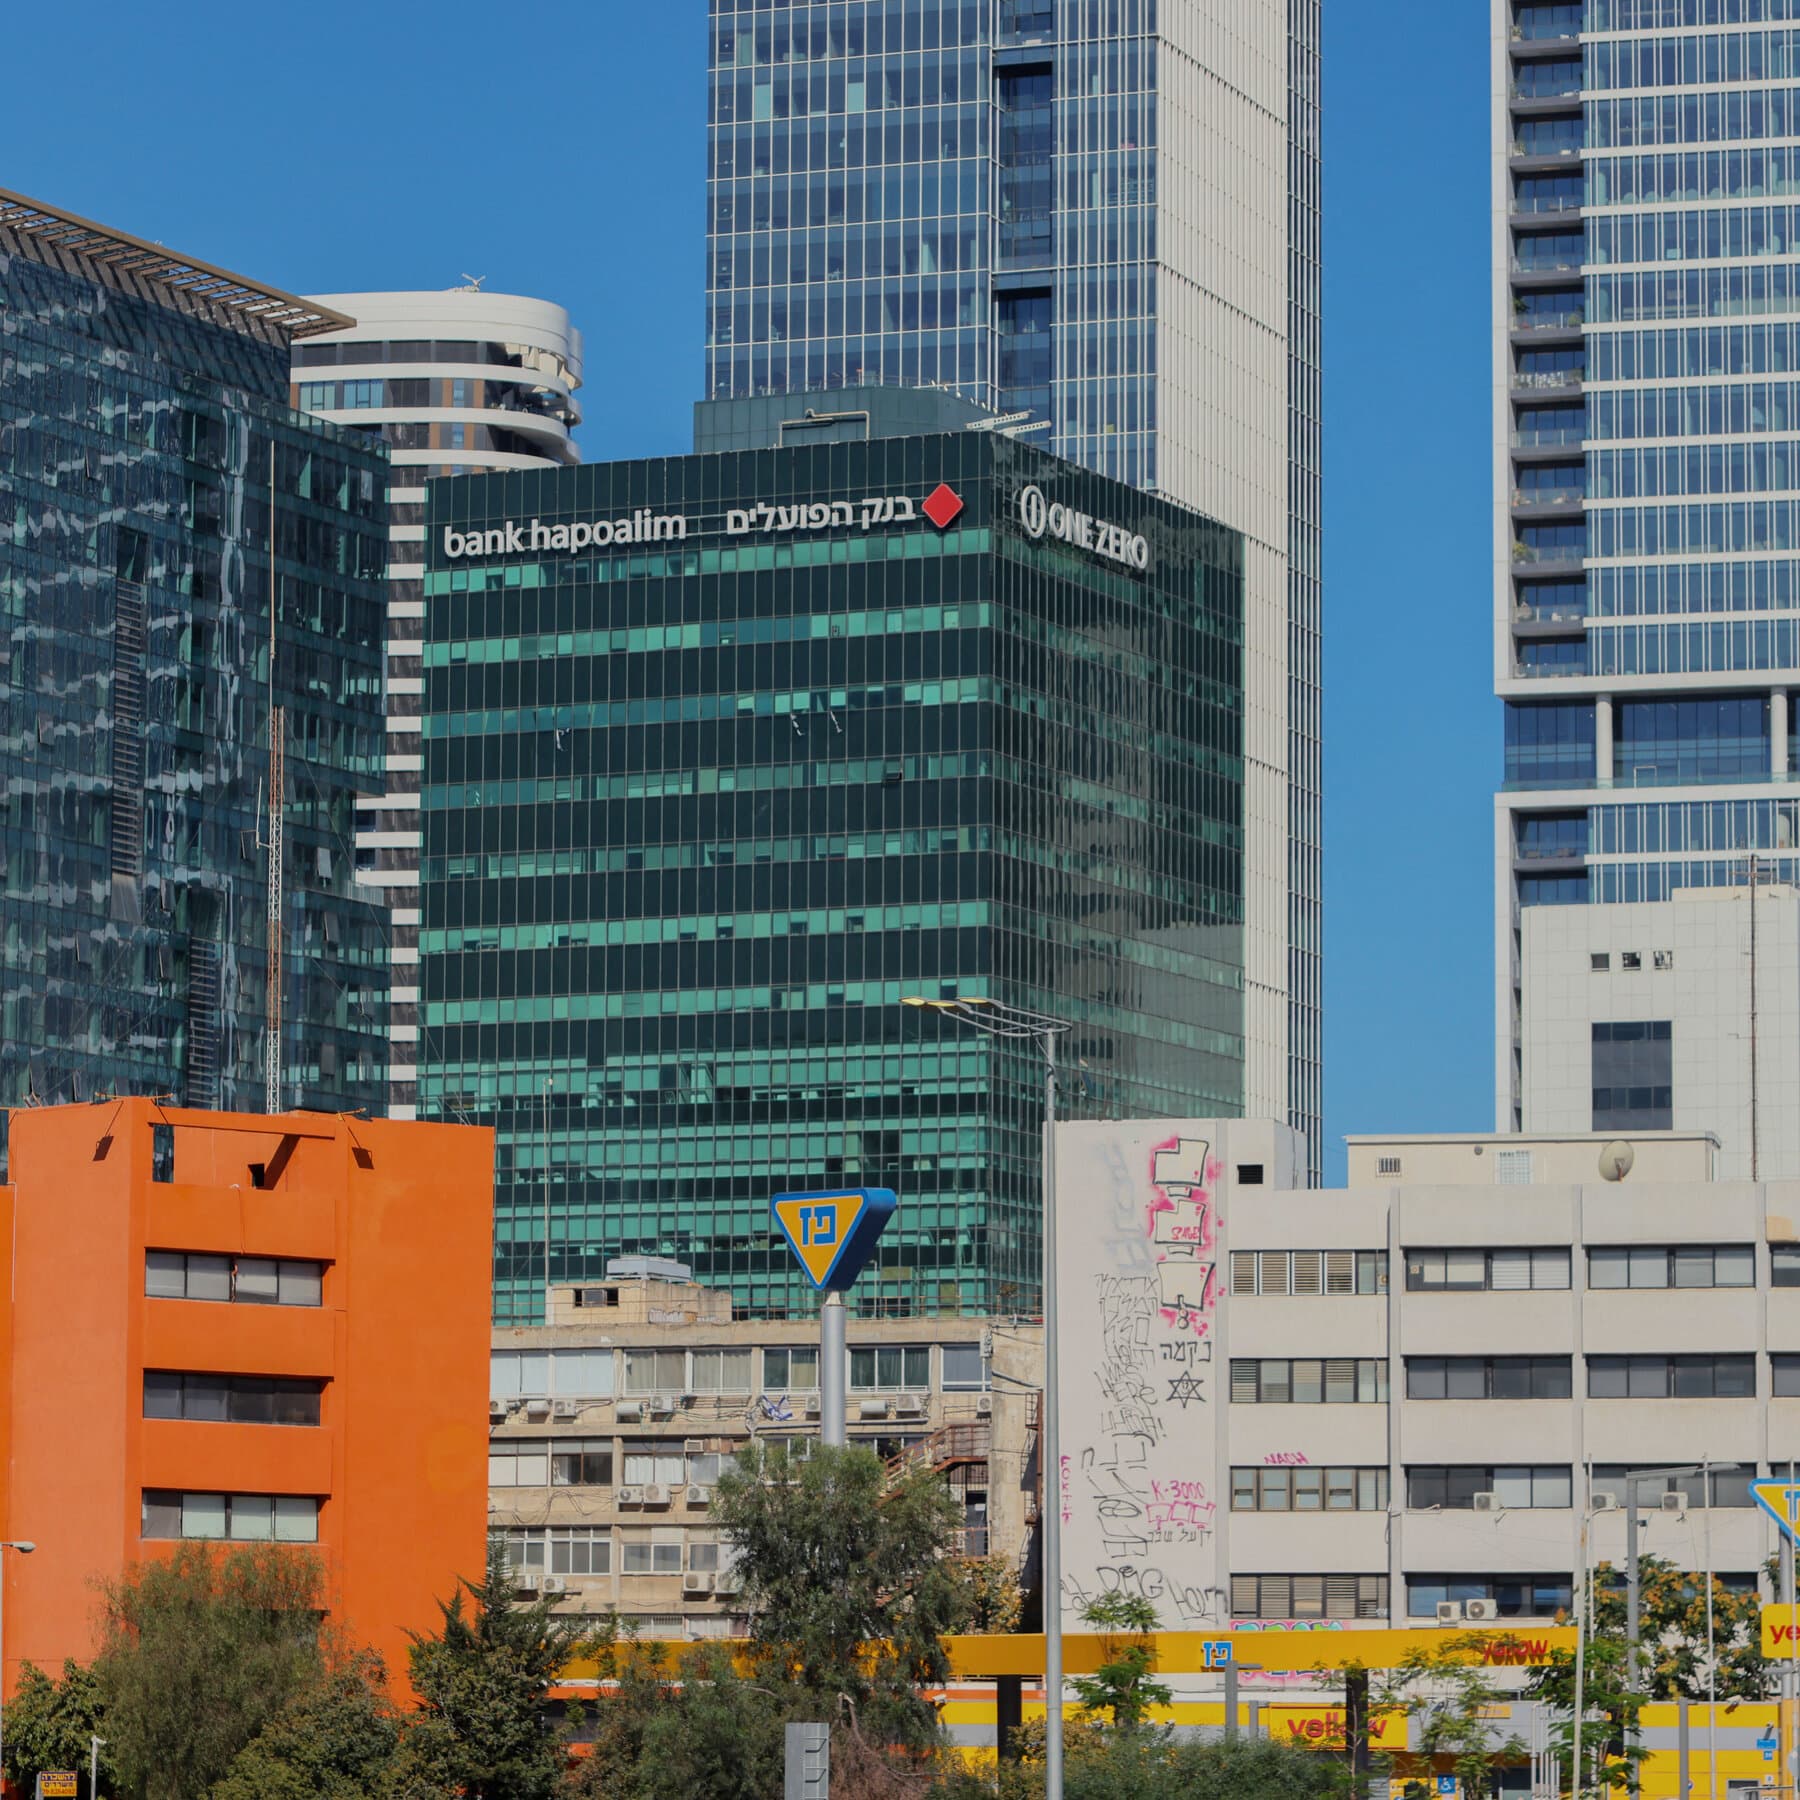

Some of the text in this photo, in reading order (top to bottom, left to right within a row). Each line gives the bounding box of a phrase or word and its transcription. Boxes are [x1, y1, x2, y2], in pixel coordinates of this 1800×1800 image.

[444, 508, 687, 558] bank hapoalim
[726, 495, 917, 535] בנק הפועלים
[1049, 502, 1149, 569] ONE ZERO
[799, 1204, 838, 1247] פז
[1160, 1341, 1212, 1369] נקמה
[1203, 1641, 1233, 1668] פז
[1287, 1712, 1388, 1739] yellw
